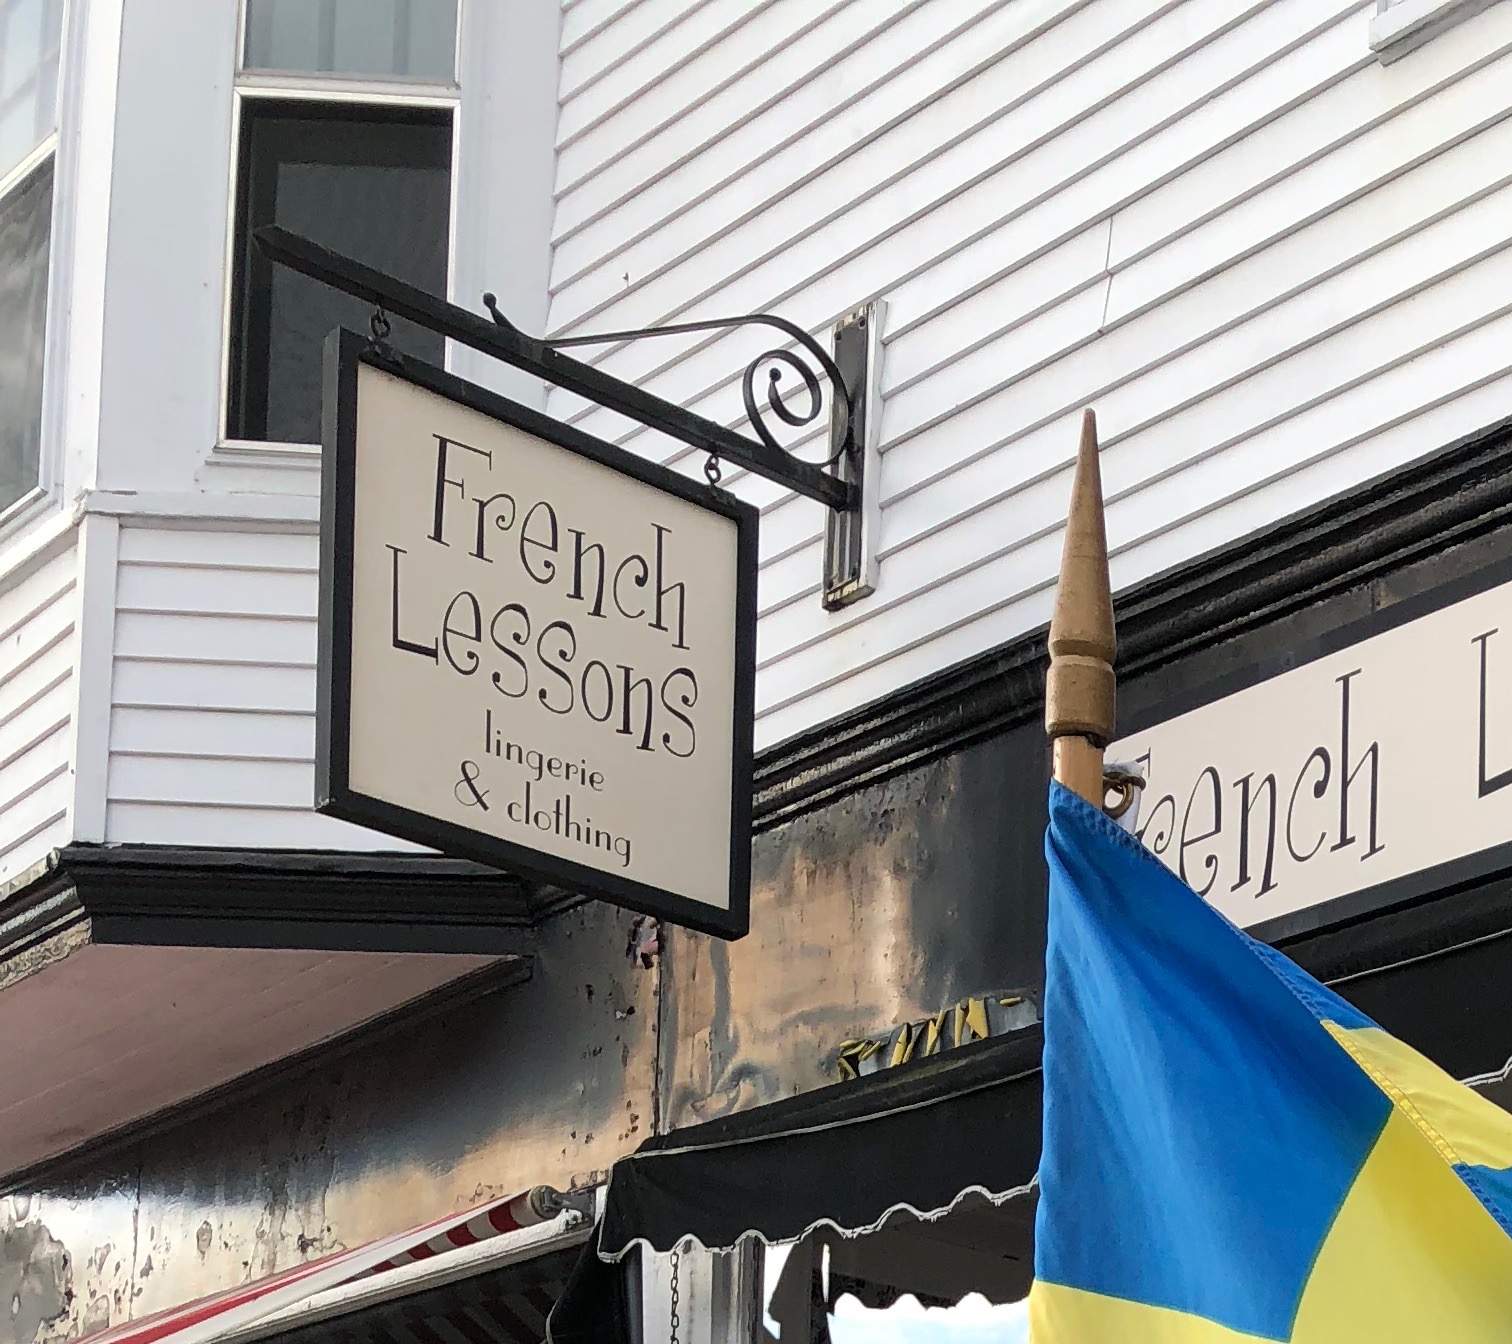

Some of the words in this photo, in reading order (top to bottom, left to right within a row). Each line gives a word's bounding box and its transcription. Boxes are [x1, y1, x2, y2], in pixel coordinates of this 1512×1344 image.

[426, 433, 692, 651] French
[385, 543, 699, 758] Lessons
[484, 708, 605, 793] lingerie
[453, 760, 490, 813] &
[506, 780, 632, 868] clothing
[1134, 667, 1386, 899] rench
